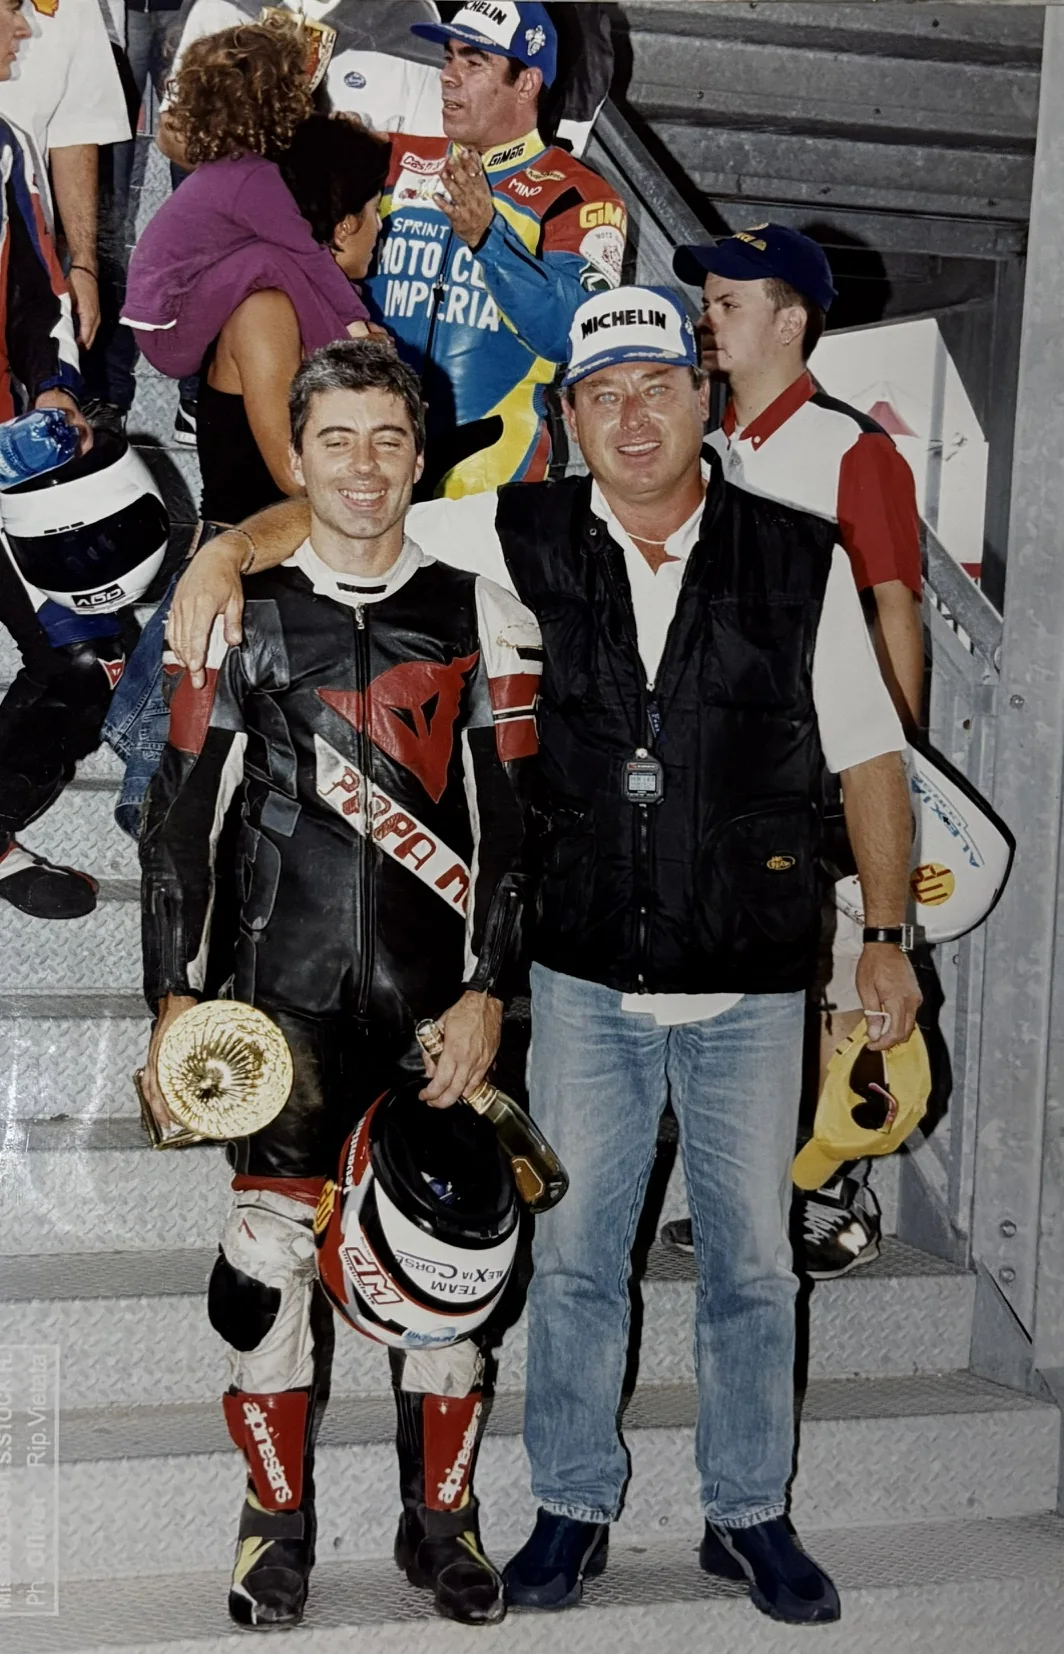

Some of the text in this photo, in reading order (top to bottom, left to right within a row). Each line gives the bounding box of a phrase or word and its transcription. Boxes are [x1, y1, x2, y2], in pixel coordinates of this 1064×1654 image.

[464, 1, 508, 26] CHELIN
[508, 178, 543, 198] MINO
[392, 217, 450, 240] SPRINT
[377, 237, 443, 279] MOTO
[580, 308, 667, 340] MICHELIN
[431, 1280, 477, 1296] TEAM
[243, 1401, 293, 1503] alpinestars
